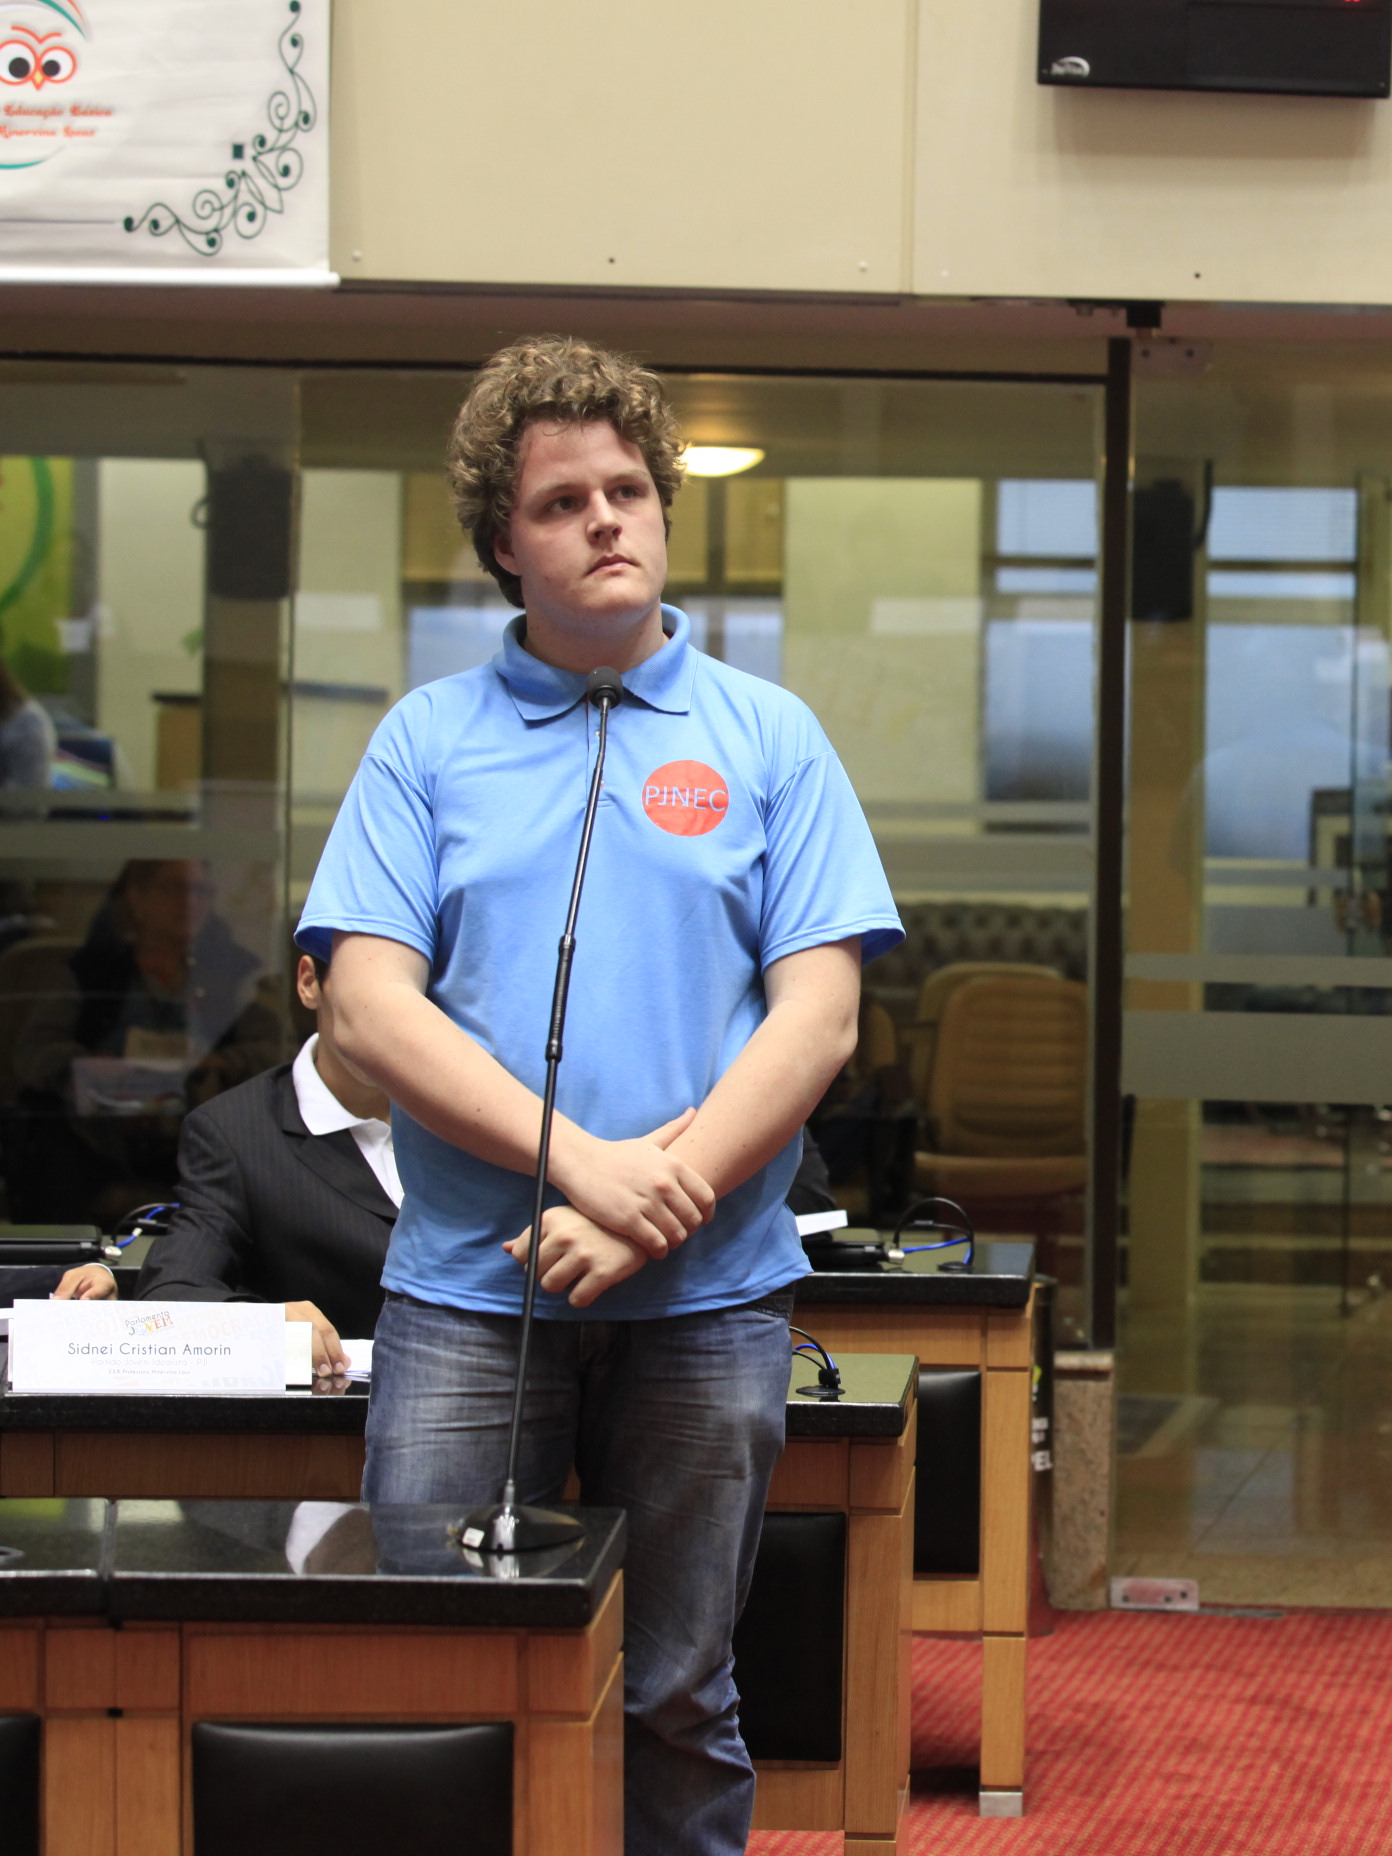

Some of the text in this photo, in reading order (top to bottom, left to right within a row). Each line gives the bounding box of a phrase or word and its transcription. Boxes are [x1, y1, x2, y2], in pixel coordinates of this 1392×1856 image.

[644, 784, 726, 812] PJNEC
[124, 1310, 171, 1328] Parlamento
[68, 1342, 231, 1357] Sidnei Cristian Amorin
[91, 1358, 122, 1367] Partido
[124, 1358, 151, 1367] Jovem
